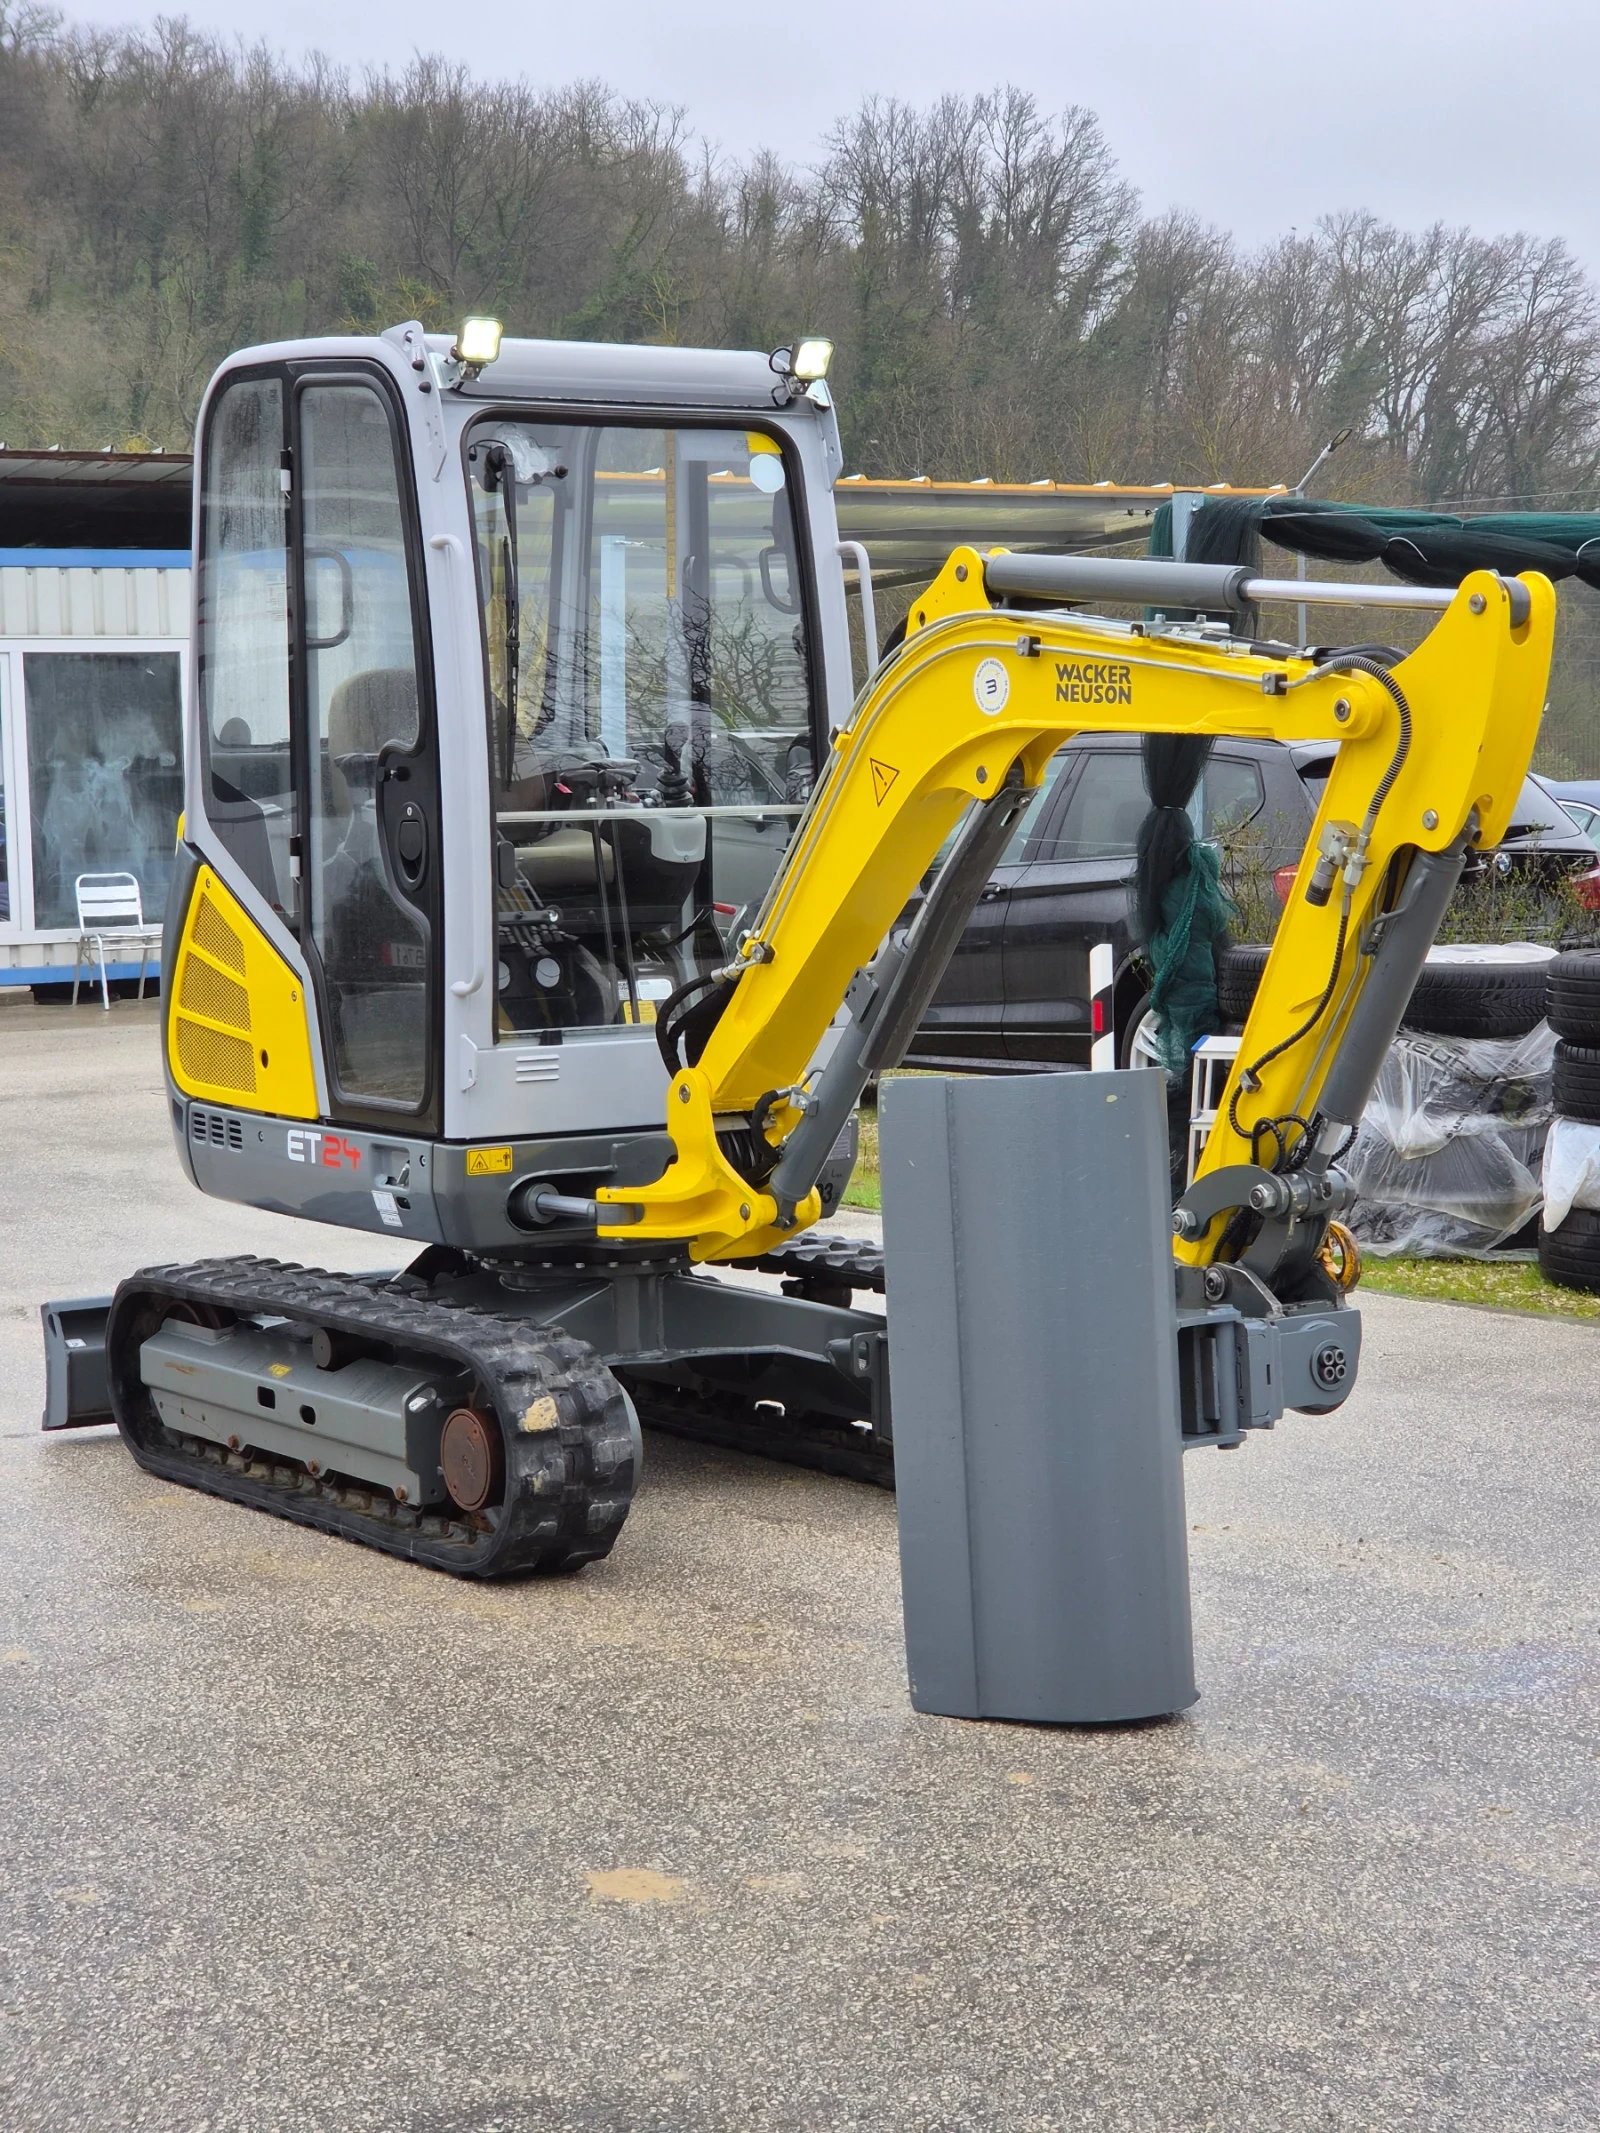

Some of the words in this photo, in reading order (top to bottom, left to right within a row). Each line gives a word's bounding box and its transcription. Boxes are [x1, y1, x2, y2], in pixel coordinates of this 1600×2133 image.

[1055, 663, 1132, 684] WACKER
[1056, 684, 1132, 704] NEUSON
[287, 1129, 361, 1170] ET24
